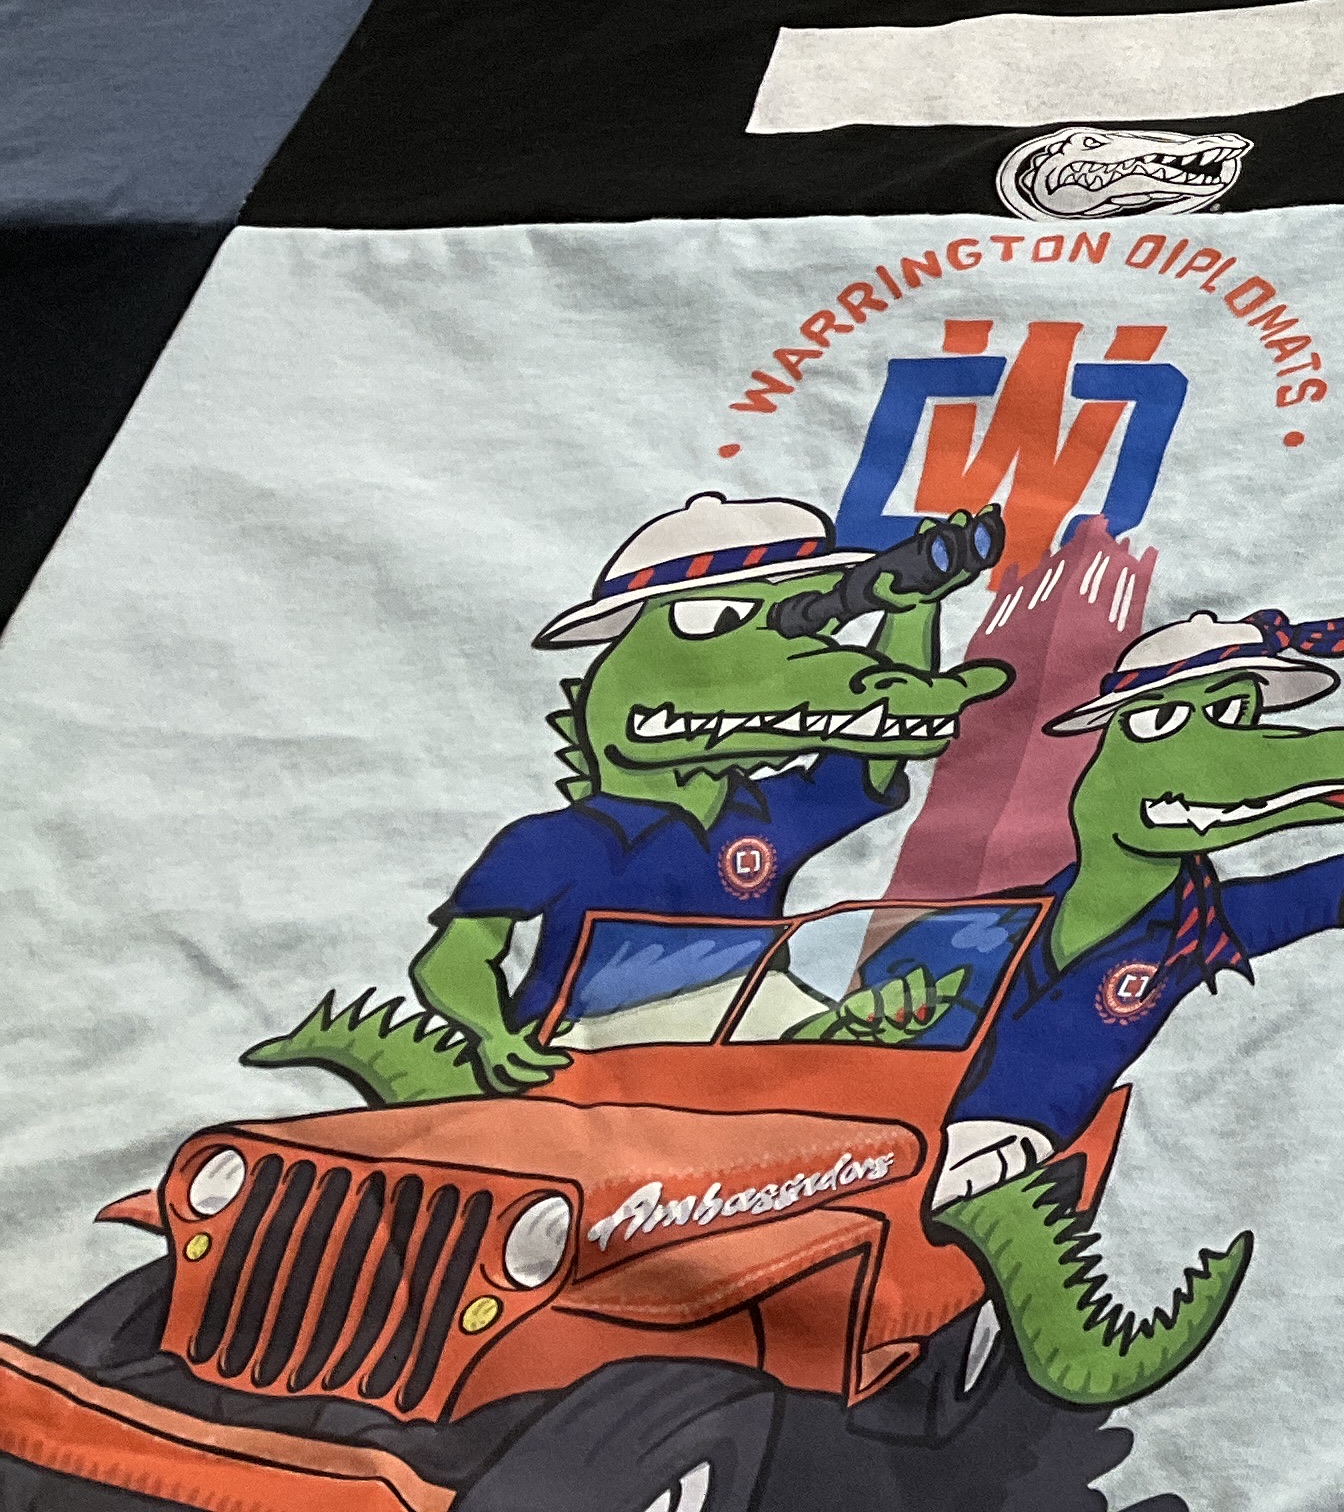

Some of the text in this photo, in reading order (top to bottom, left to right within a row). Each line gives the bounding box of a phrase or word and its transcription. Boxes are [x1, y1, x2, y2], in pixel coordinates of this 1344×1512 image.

[729, 231, 1329, 415] WARRINGTON DIPLOMATS
[586, 1148, 898, 1254] Ambassadors
